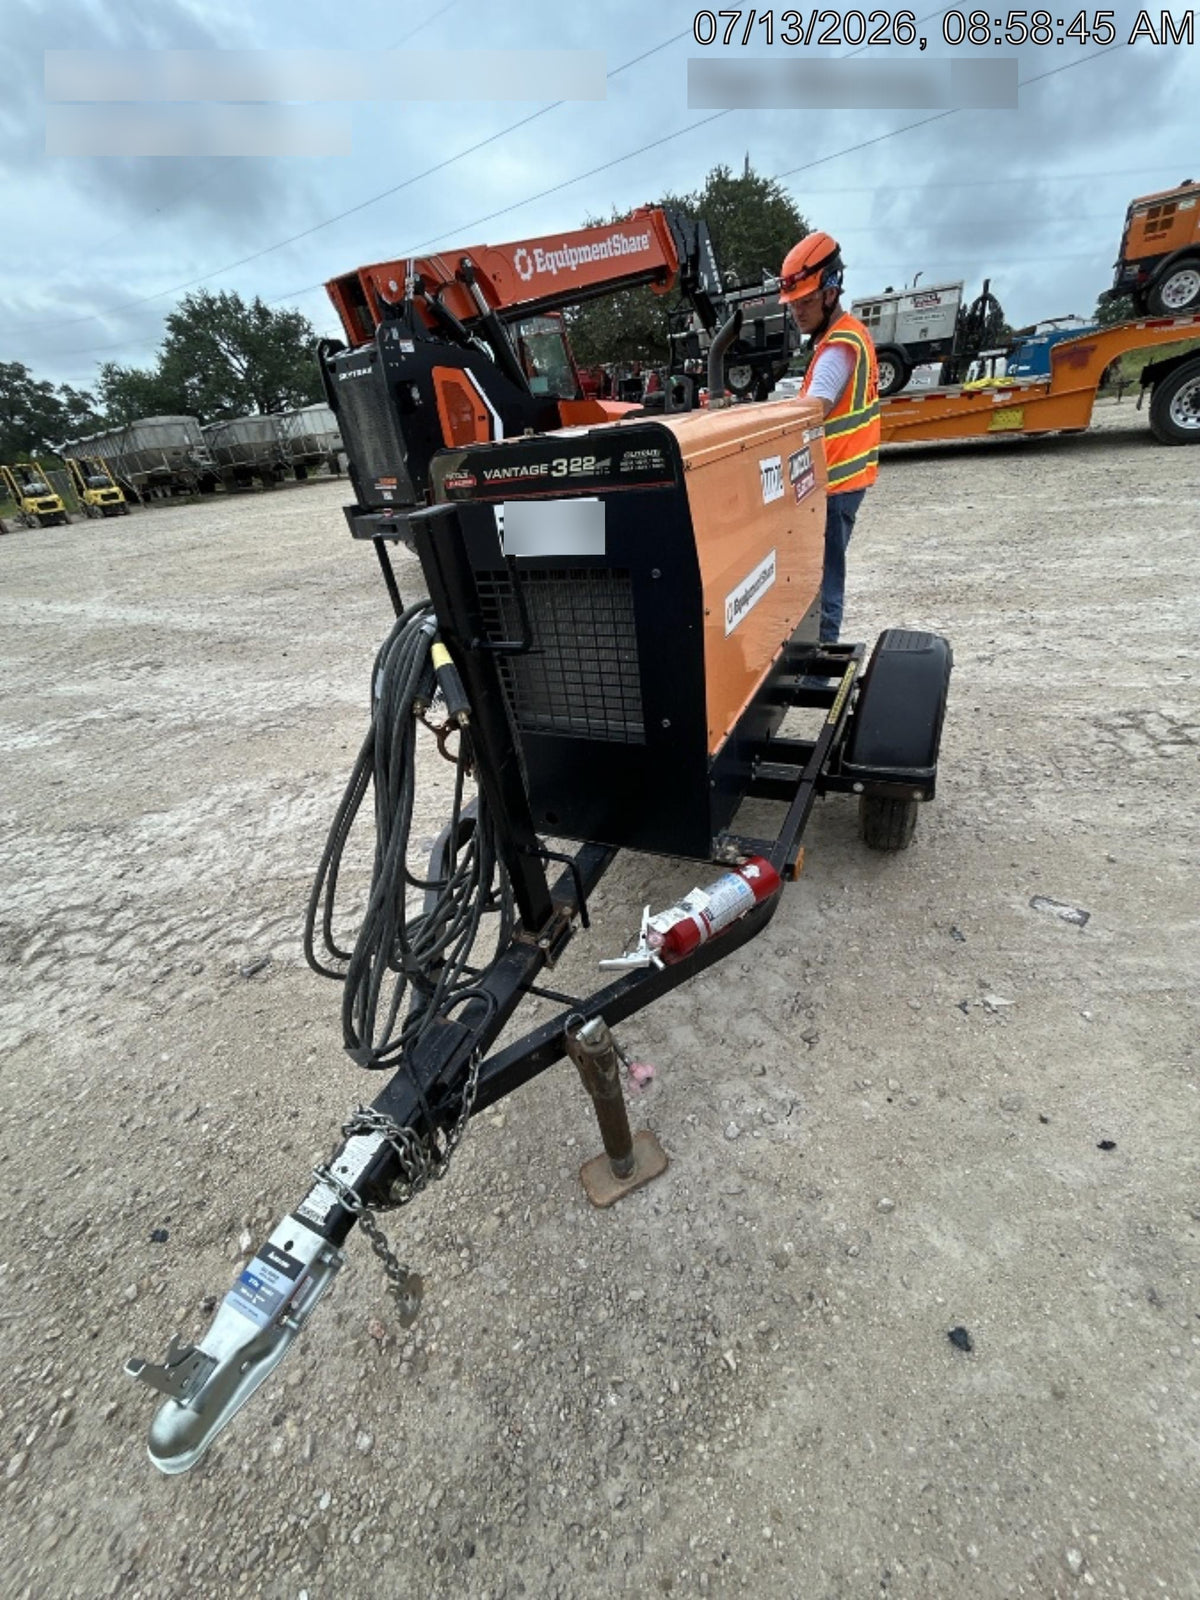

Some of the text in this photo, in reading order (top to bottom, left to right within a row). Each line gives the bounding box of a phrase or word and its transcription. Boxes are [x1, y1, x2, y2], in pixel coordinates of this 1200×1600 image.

[535, 233, 651, 273] EquipmentShare
[483, 463, 549, 480] VANTAGE
[551, 456, 596, 478] 322
